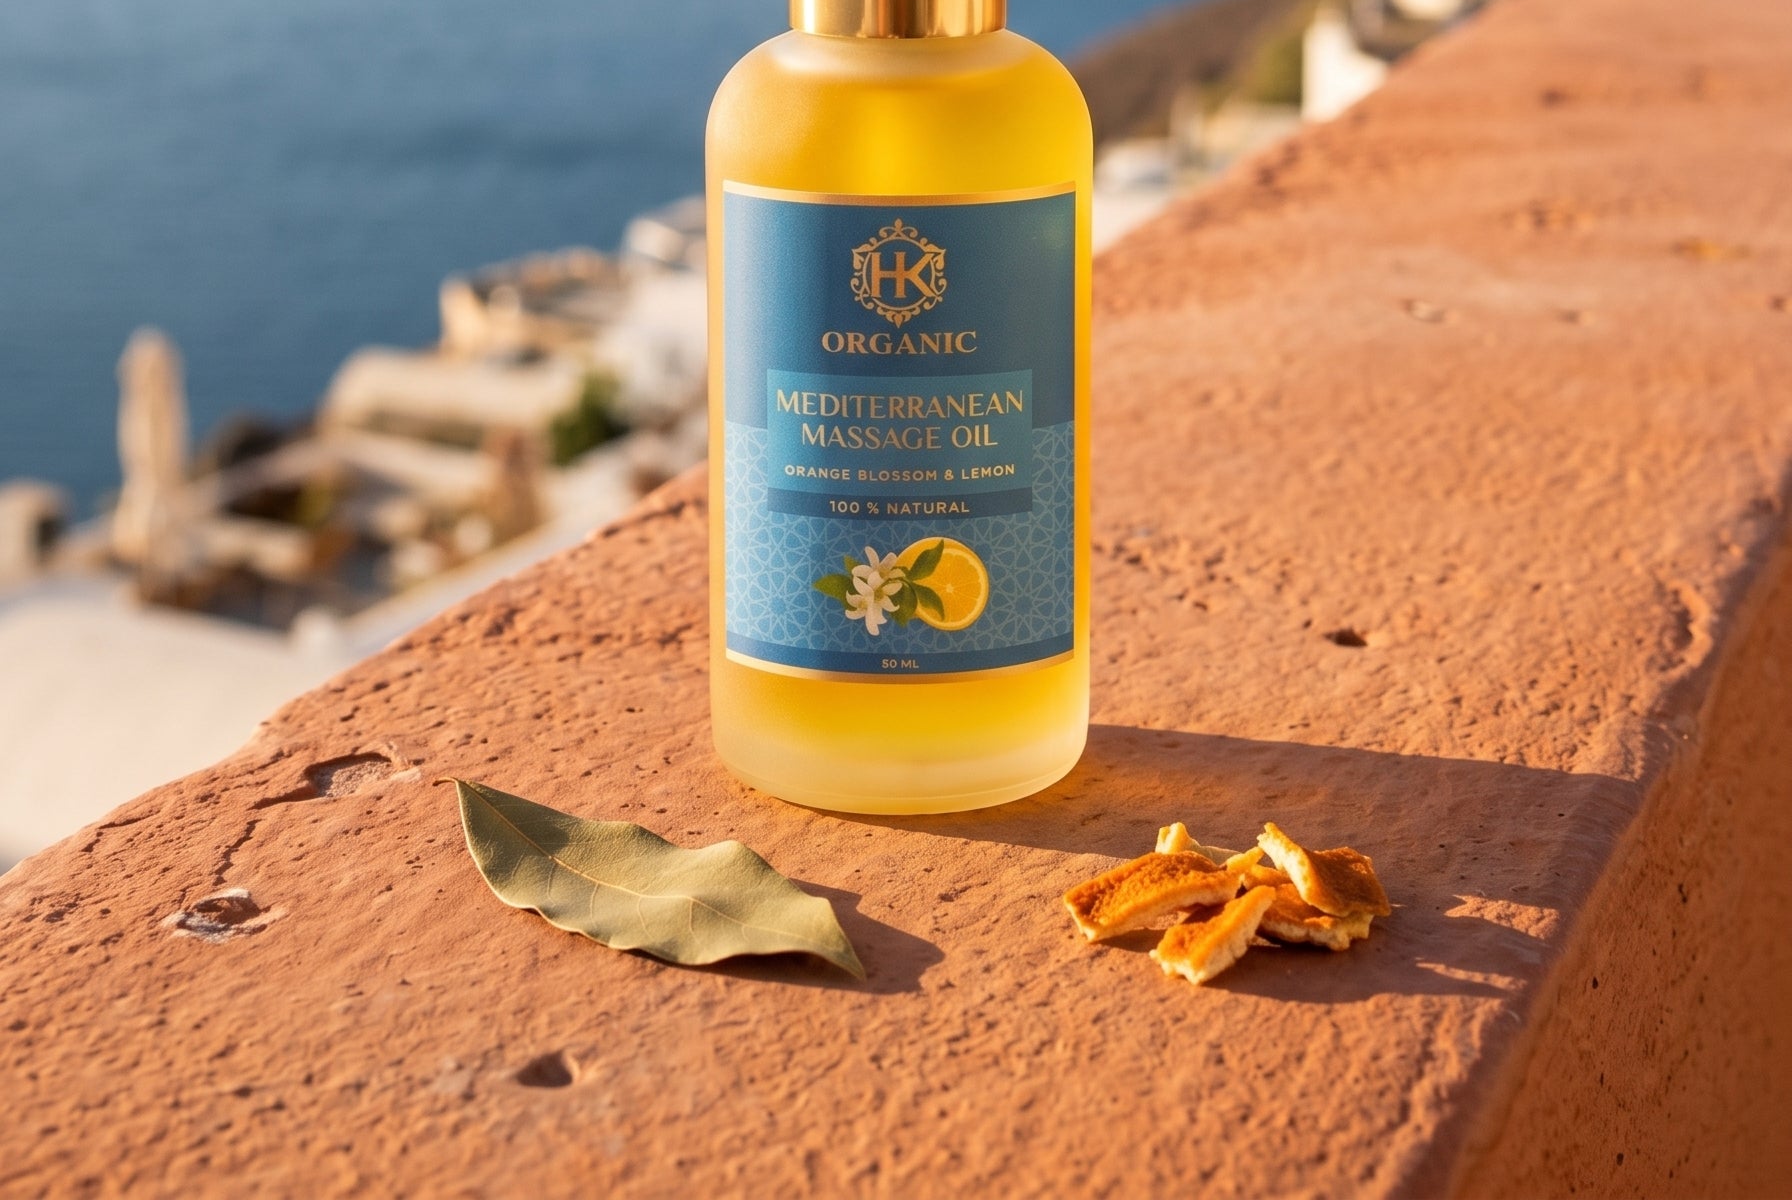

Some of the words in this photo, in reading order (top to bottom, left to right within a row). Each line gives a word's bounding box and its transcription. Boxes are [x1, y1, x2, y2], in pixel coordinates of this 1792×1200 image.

[870, 251, 936, 299] HK
[821, 330, 977, 355] ORGANIC
[776, 389, 1023, 420] MEDITERRANEAN
[801, 423, 942, 450] MASSAGE
[951, 424, 998, 448] OIL
[784, 464, 851, 480] ORANGE
[858, 469, 937, 482] BLOSSOM
[944, 468, 954, 480] &
[961, 464, 1015, 479] LEMON
[829, 500, 860, 514] 100
[866, 502, 880, 515] %
[887, 500, 970, 515] NATURAL
[882, 658, 897, 669] 50
[900, 658, 919, 669] ML
